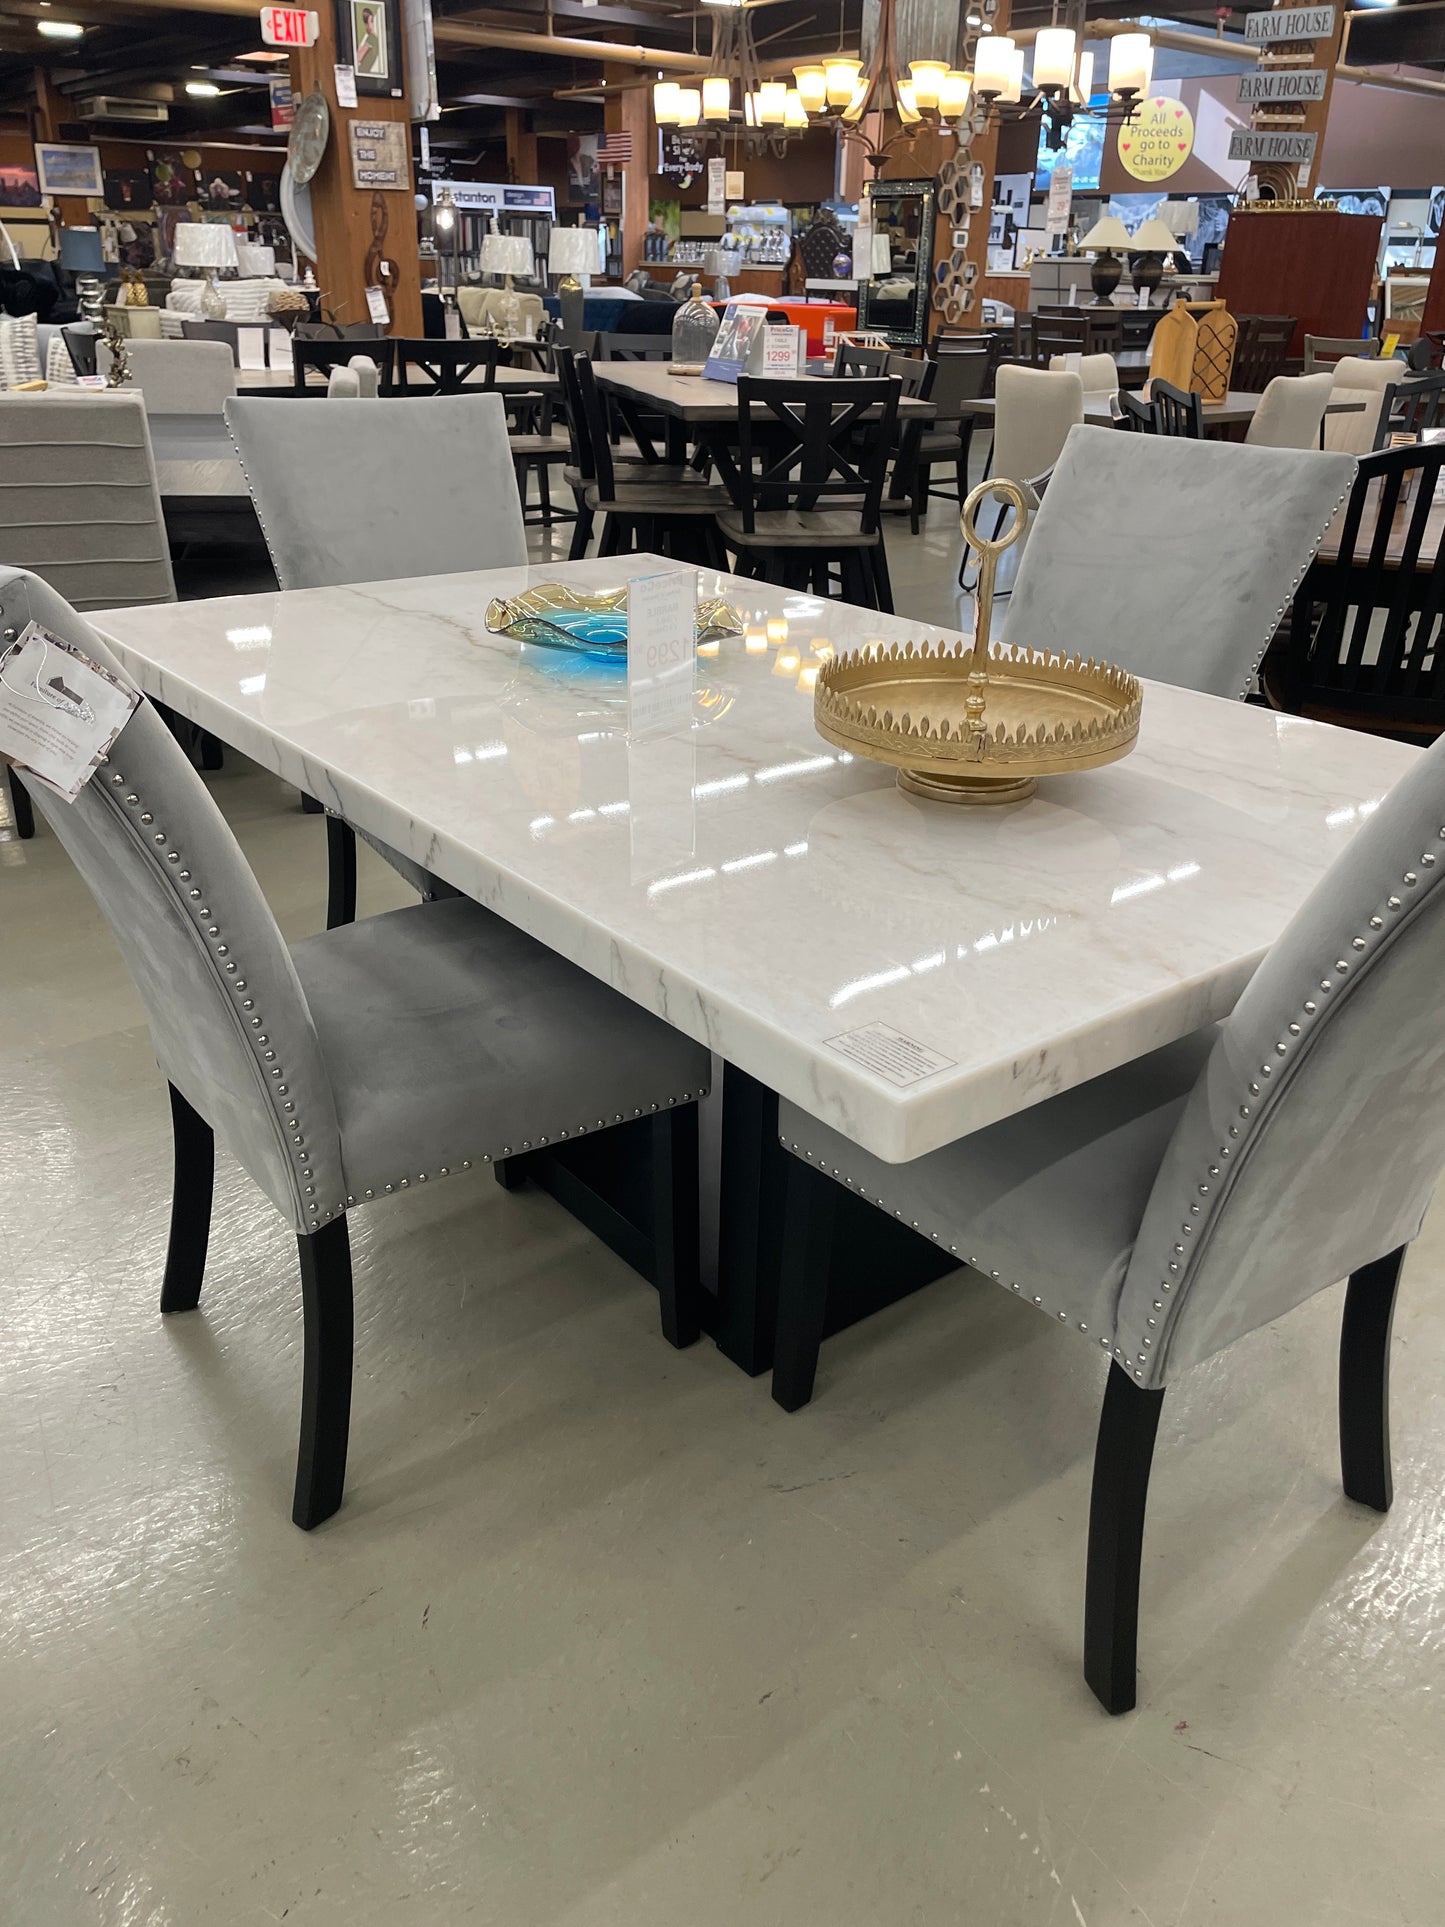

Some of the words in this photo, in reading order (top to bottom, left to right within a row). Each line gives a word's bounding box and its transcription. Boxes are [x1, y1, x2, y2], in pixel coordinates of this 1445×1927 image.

[272, 9, 307, 43] EXIT
[1246, 15, 1281, 38] FARM
[1285, 11, 1331, 35] HOUSE
[1239, 77, 1274, 98] FARM
[1276, 75, 1322, 97] HOUSE
[1150, 113, 1167, 124] All
[356, 127, 385, 138] ENJOY
[1130, 125, 1183, 137] Proceeds
[1140, 140, 1155, 152] go
[1158, 140, 1170, 149] to
[1230, 136, 1264, 157] FARM
[1267, 137, 1312, 158] HOUSE
[358, 149, 376, 159] THE
[1132, 153, 1174, 168] Charity
[359, 170, 396, 181] MOMENT
[453, 190, 496, 203] stanton
[766, 350, 791, 362] 1299
